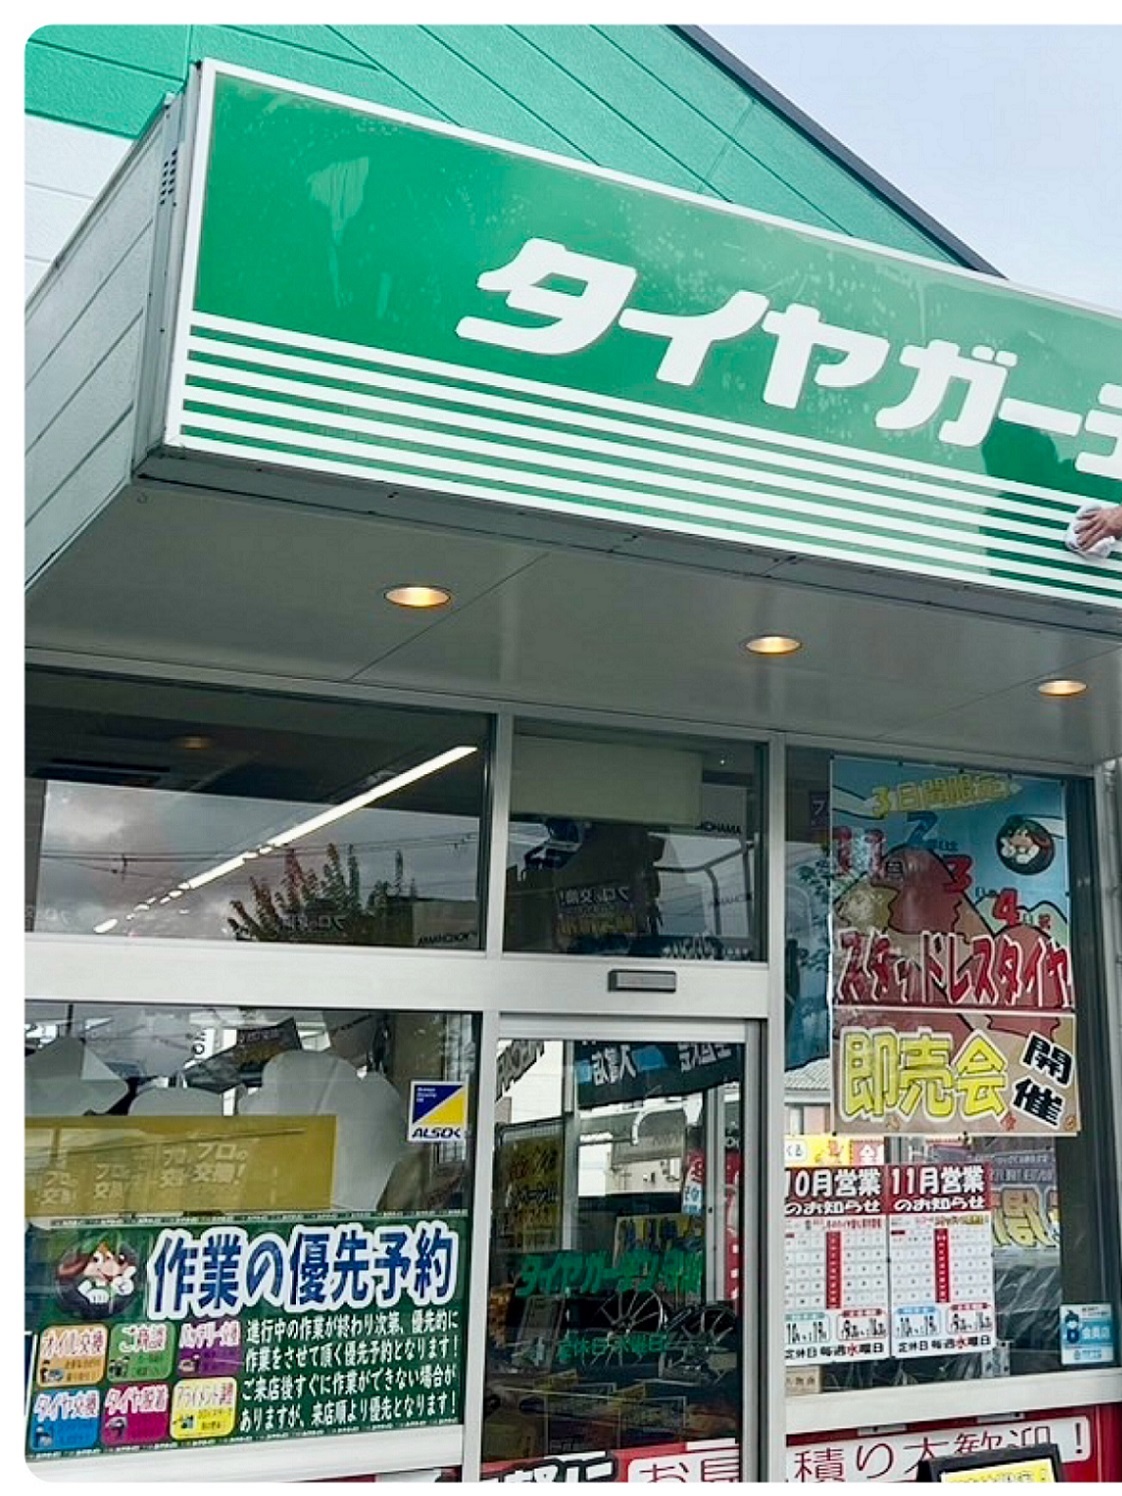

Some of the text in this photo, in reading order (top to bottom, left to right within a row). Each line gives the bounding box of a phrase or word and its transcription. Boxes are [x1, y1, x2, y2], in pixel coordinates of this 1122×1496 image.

[840, 1027, 1008, 1121] 即売会
[1011, 1033, 1075, 1129] 開催
[412, 1127, 461, 1139] ALSOK
[891, 1165, 985, 1196] 11月営業
[785, 1199, 882, 1216] のお知らせ
[894, 1196, 986, 1213] のお知らせ
[151, 1225, 456, 1316] 作業の優先予約
